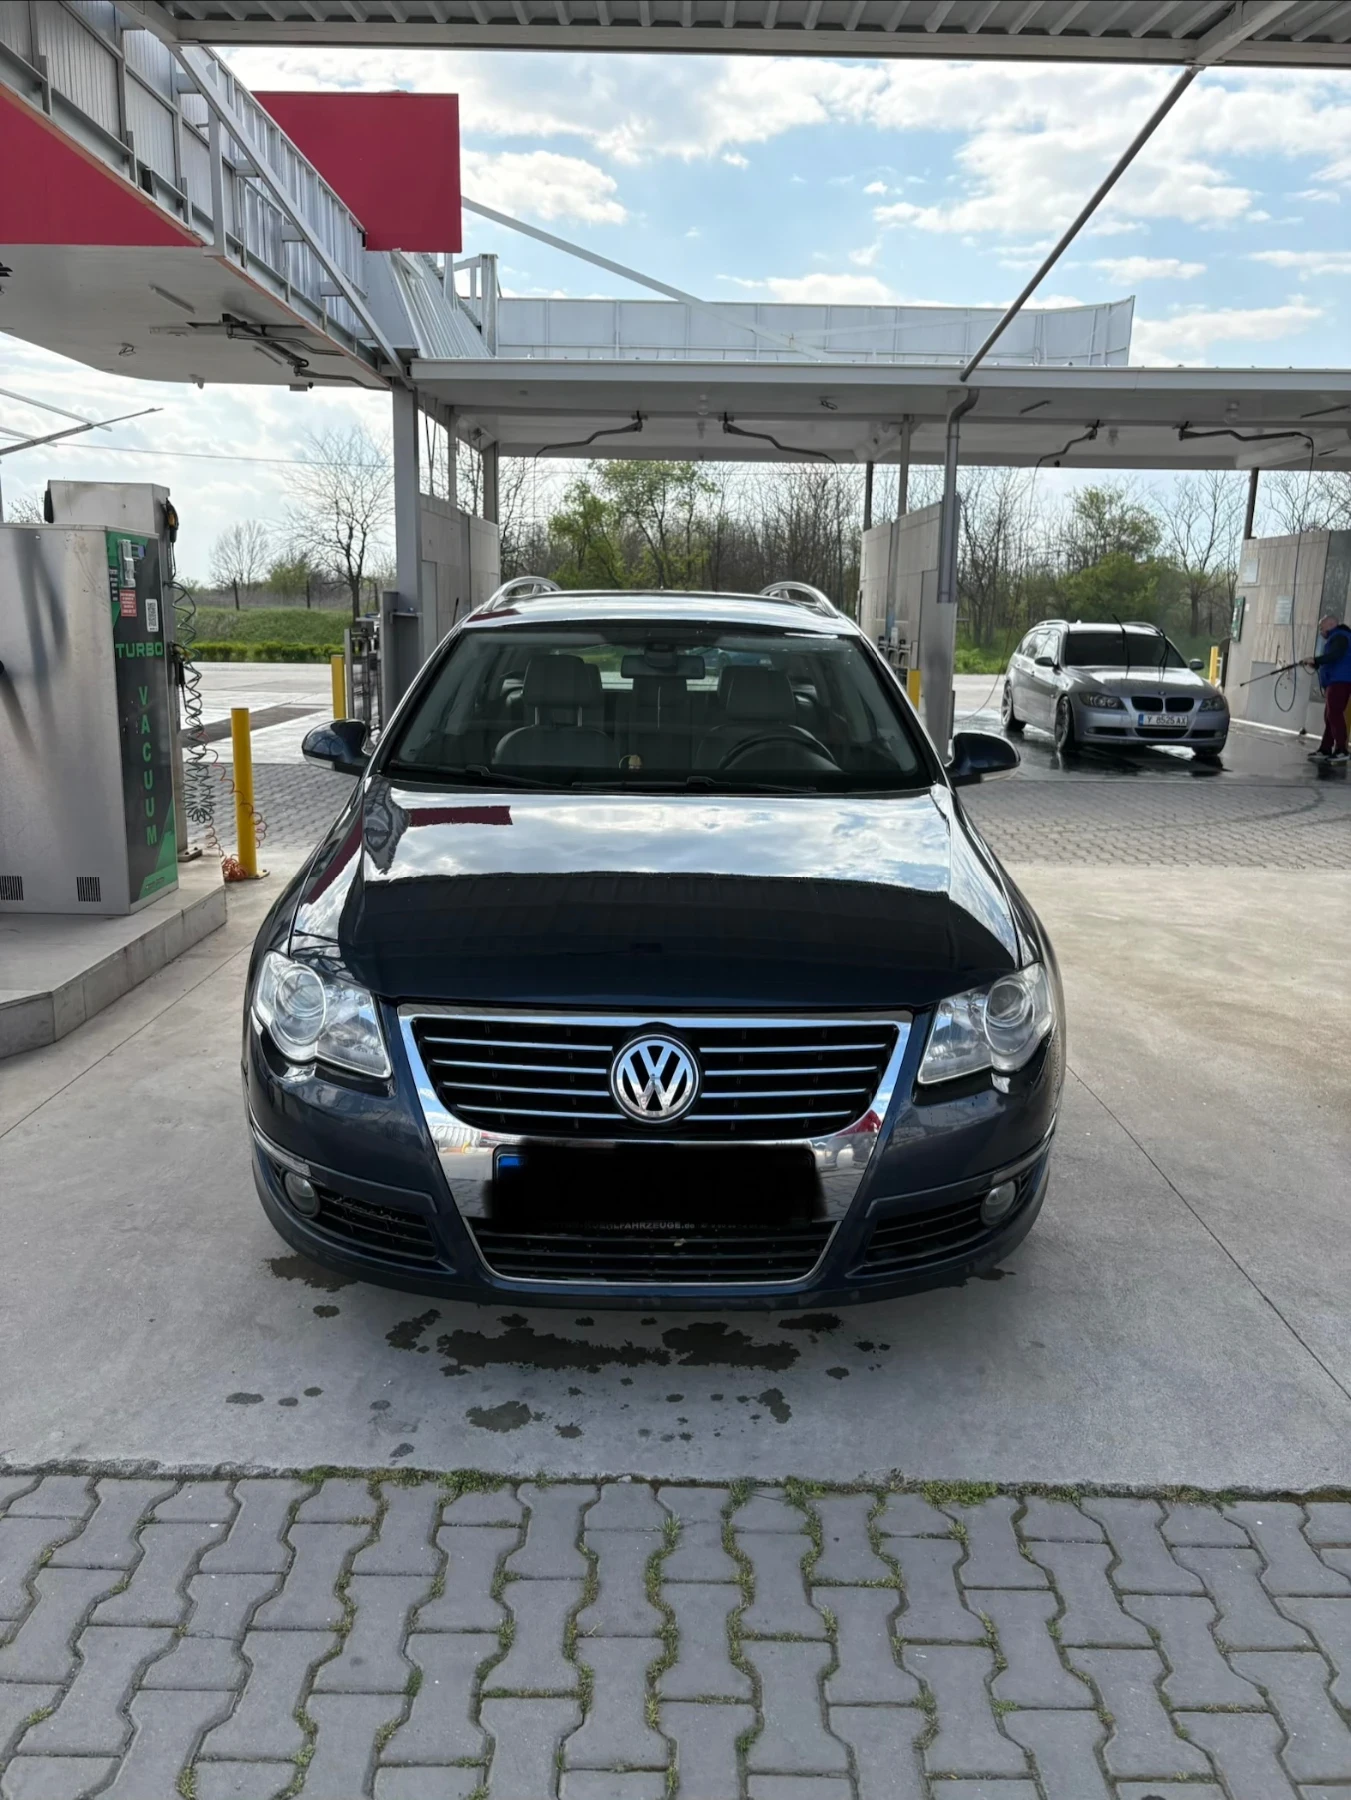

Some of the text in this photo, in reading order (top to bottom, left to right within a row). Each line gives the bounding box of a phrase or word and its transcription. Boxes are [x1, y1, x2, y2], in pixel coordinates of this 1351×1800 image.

[115, 642, 164, 658] TURBO
[138, 686, 157, 846] VACUUM
[616, 1039, 694, 1118] VW
